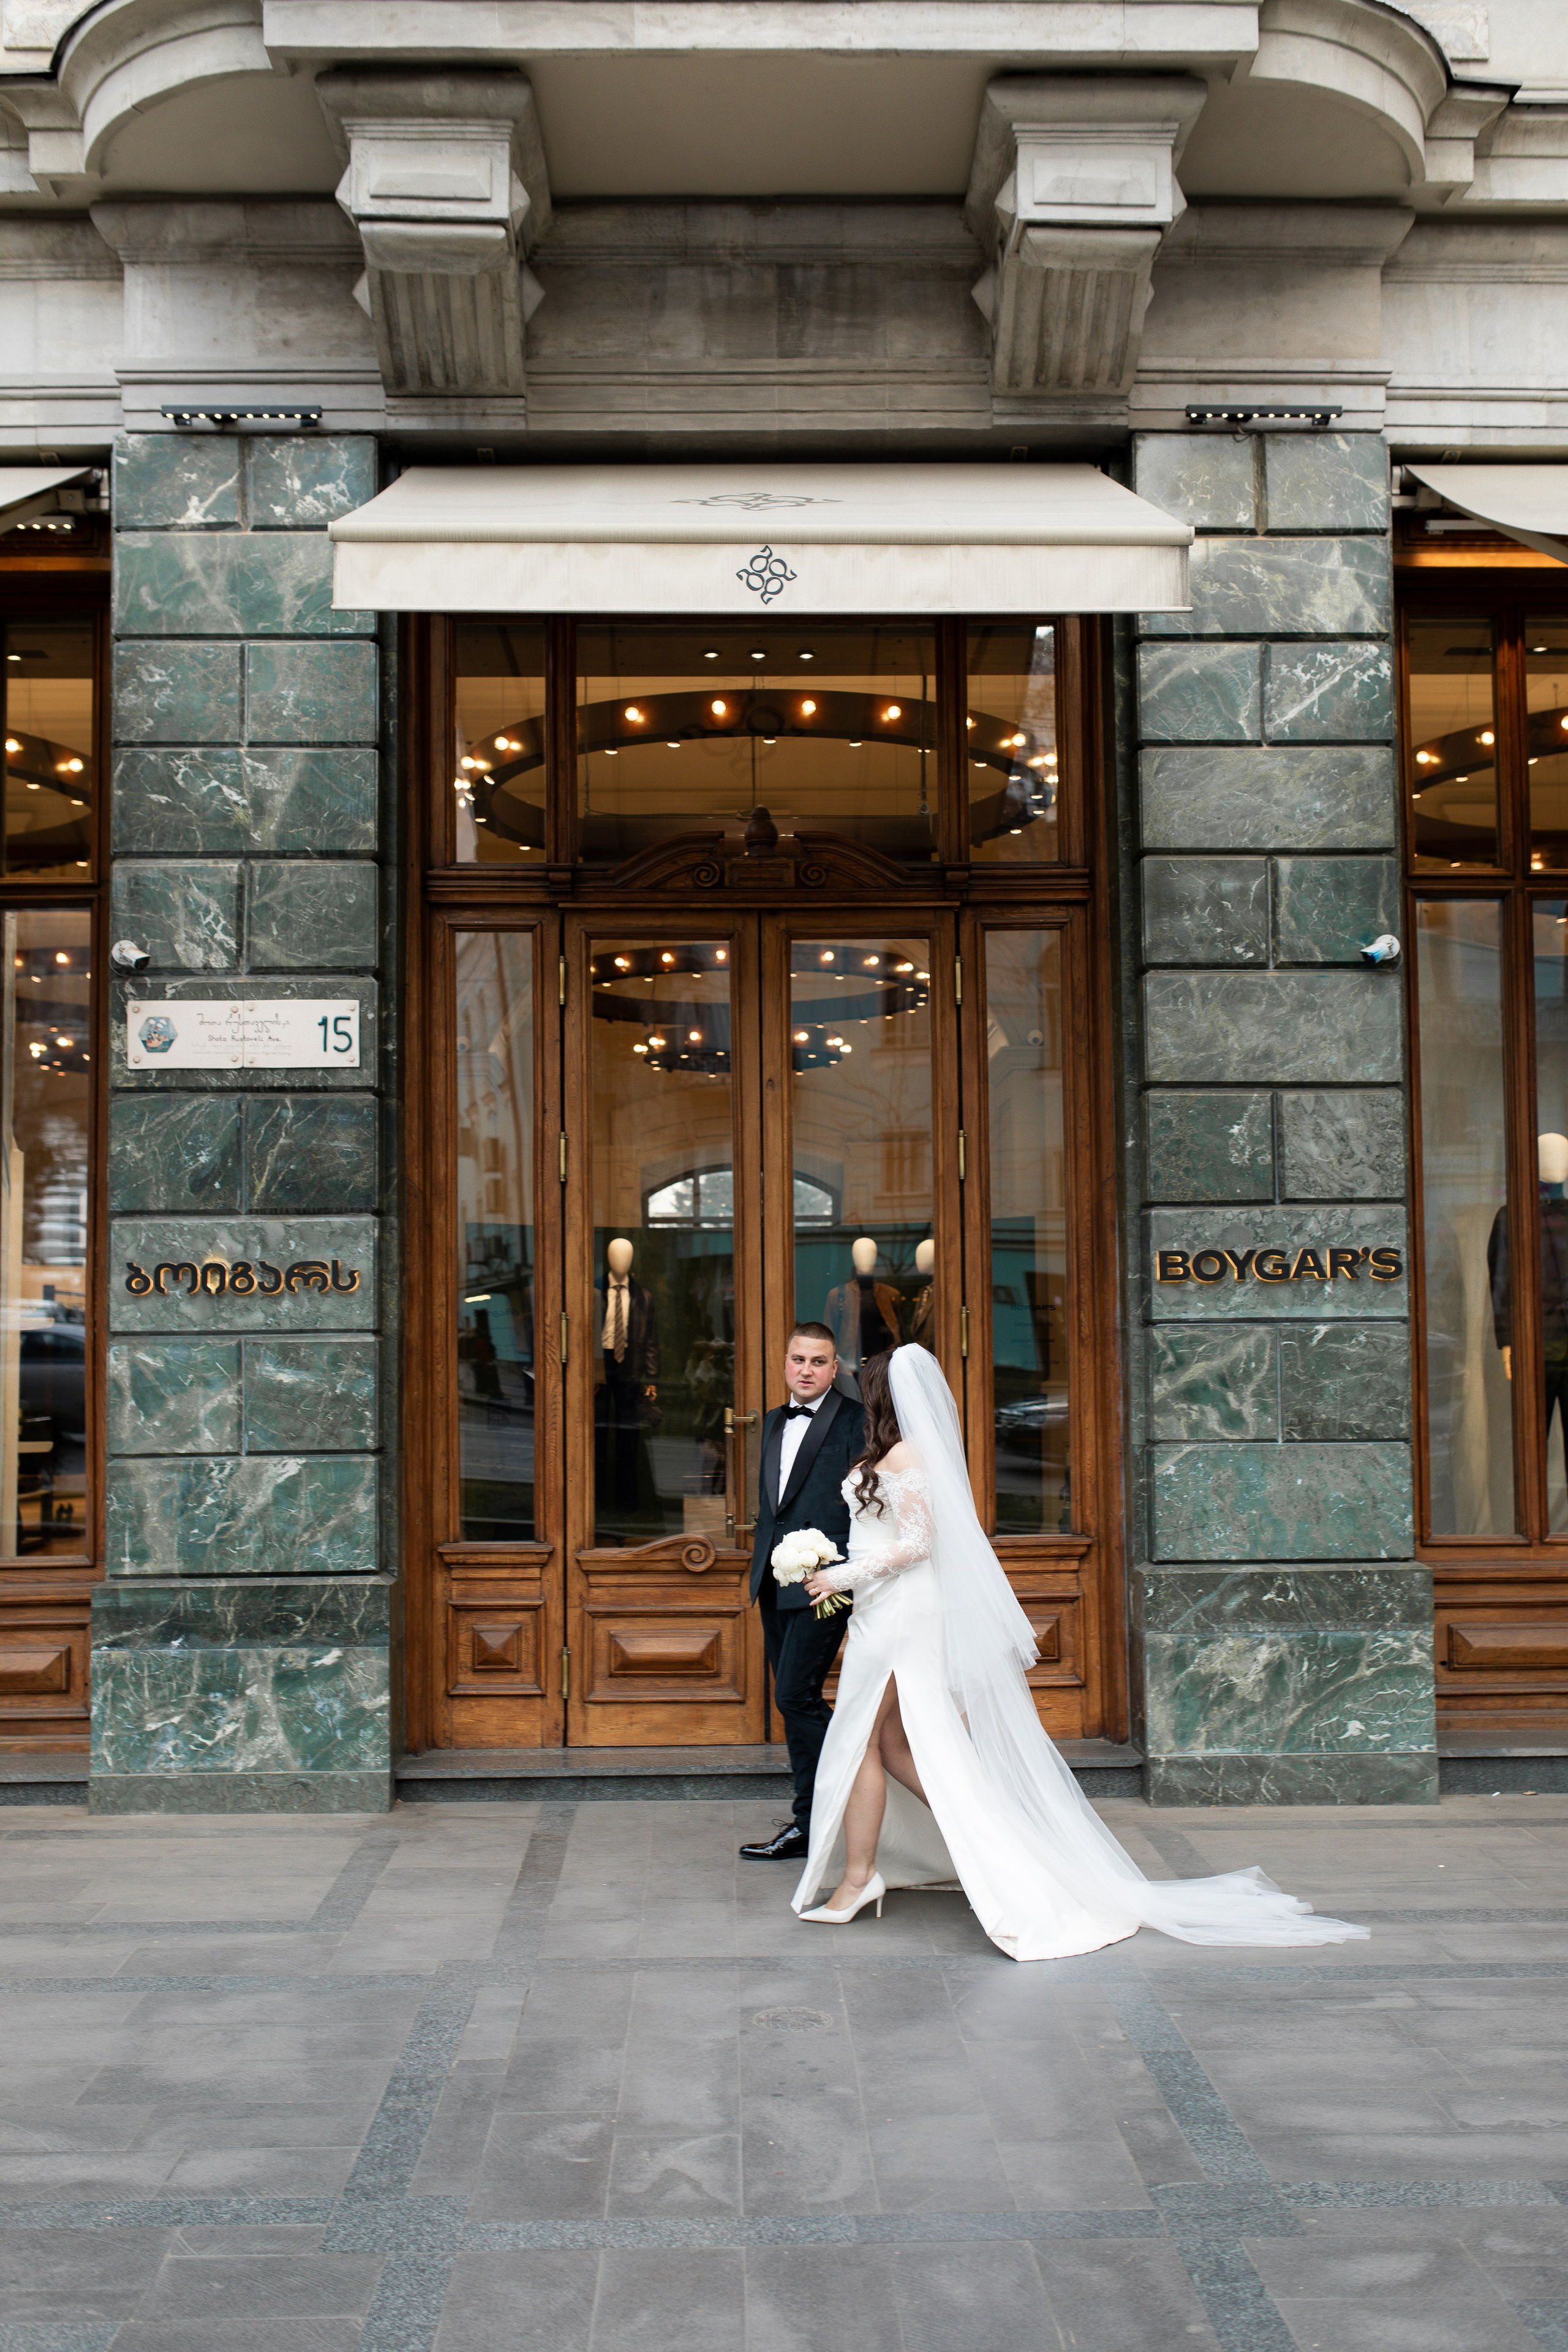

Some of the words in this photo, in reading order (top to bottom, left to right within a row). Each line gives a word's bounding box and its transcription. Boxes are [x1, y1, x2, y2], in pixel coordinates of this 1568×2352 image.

[317, 1015, 353, 1053] 15
[125, 1259, 361, 1296] ბოიგარს
[1156, 1246, 1403, 1283] BOYGAR'S
